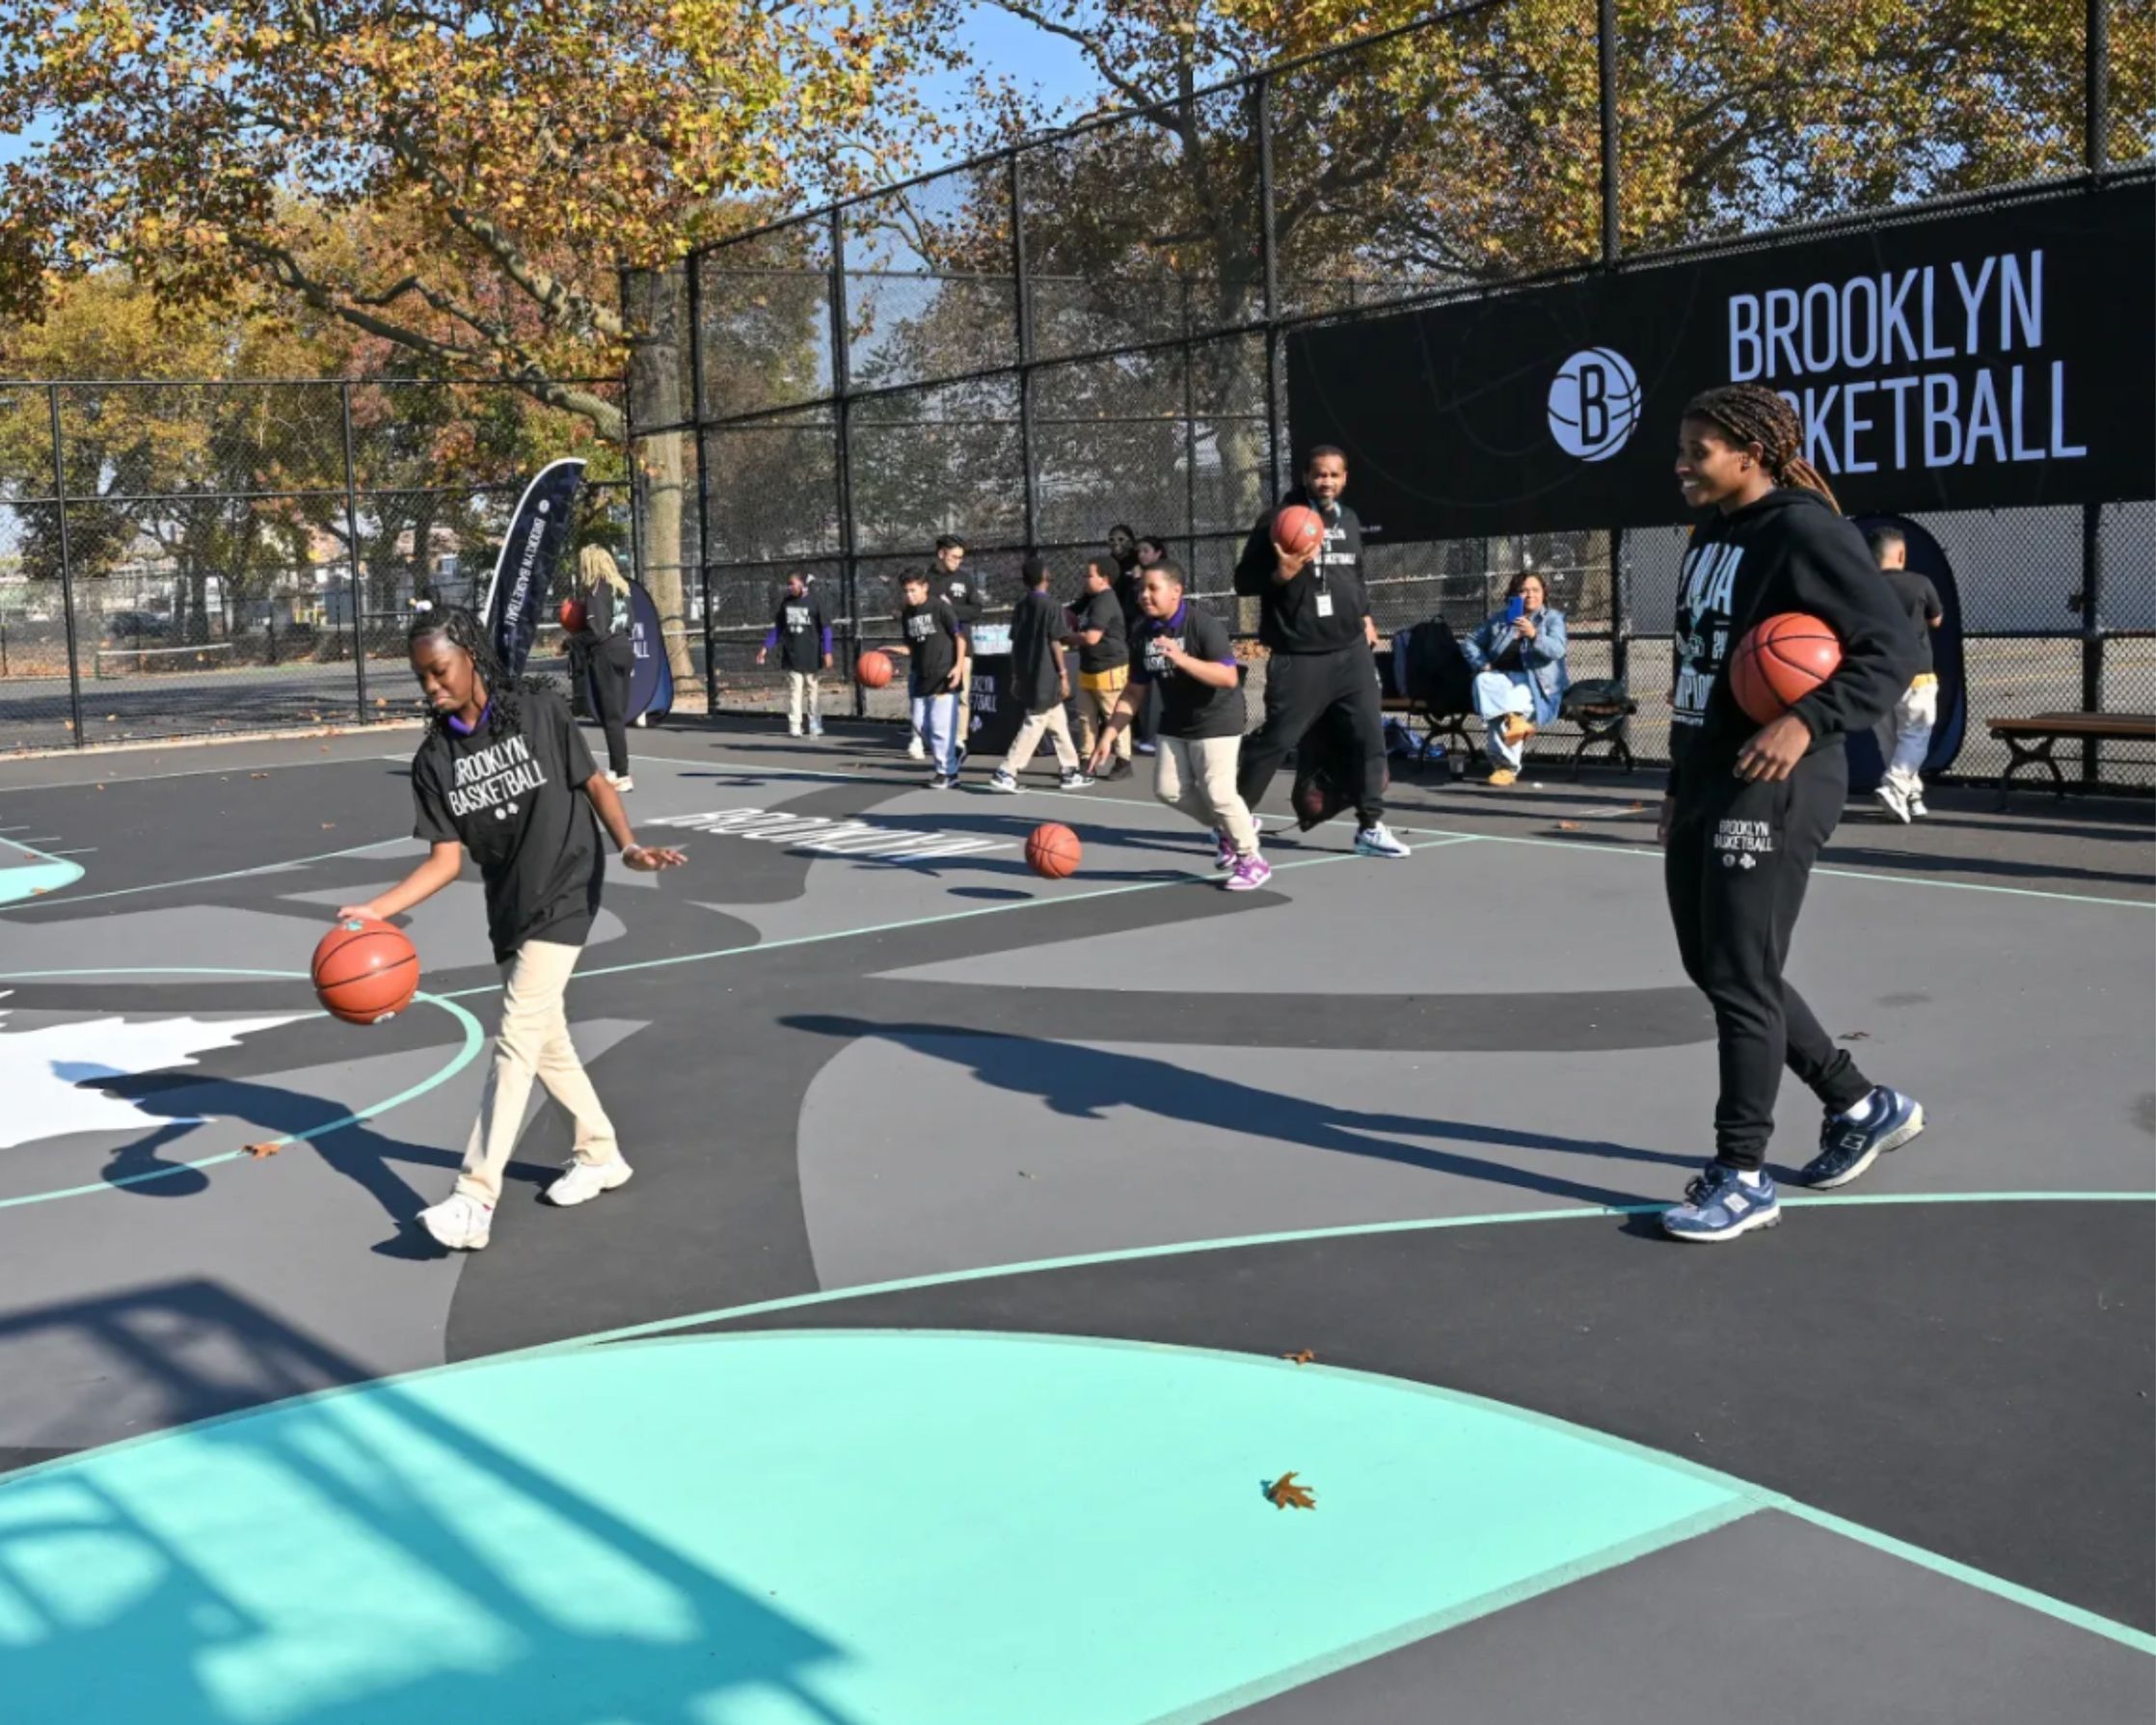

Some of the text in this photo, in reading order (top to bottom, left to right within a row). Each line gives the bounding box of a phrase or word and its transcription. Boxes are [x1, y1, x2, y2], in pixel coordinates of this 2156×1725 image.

[1728, 249, 2043, 382] BROOKLYN
[1777, 360, 2088, 475] KETBALL
[448, 759, 548, 817] BASKETBALL
